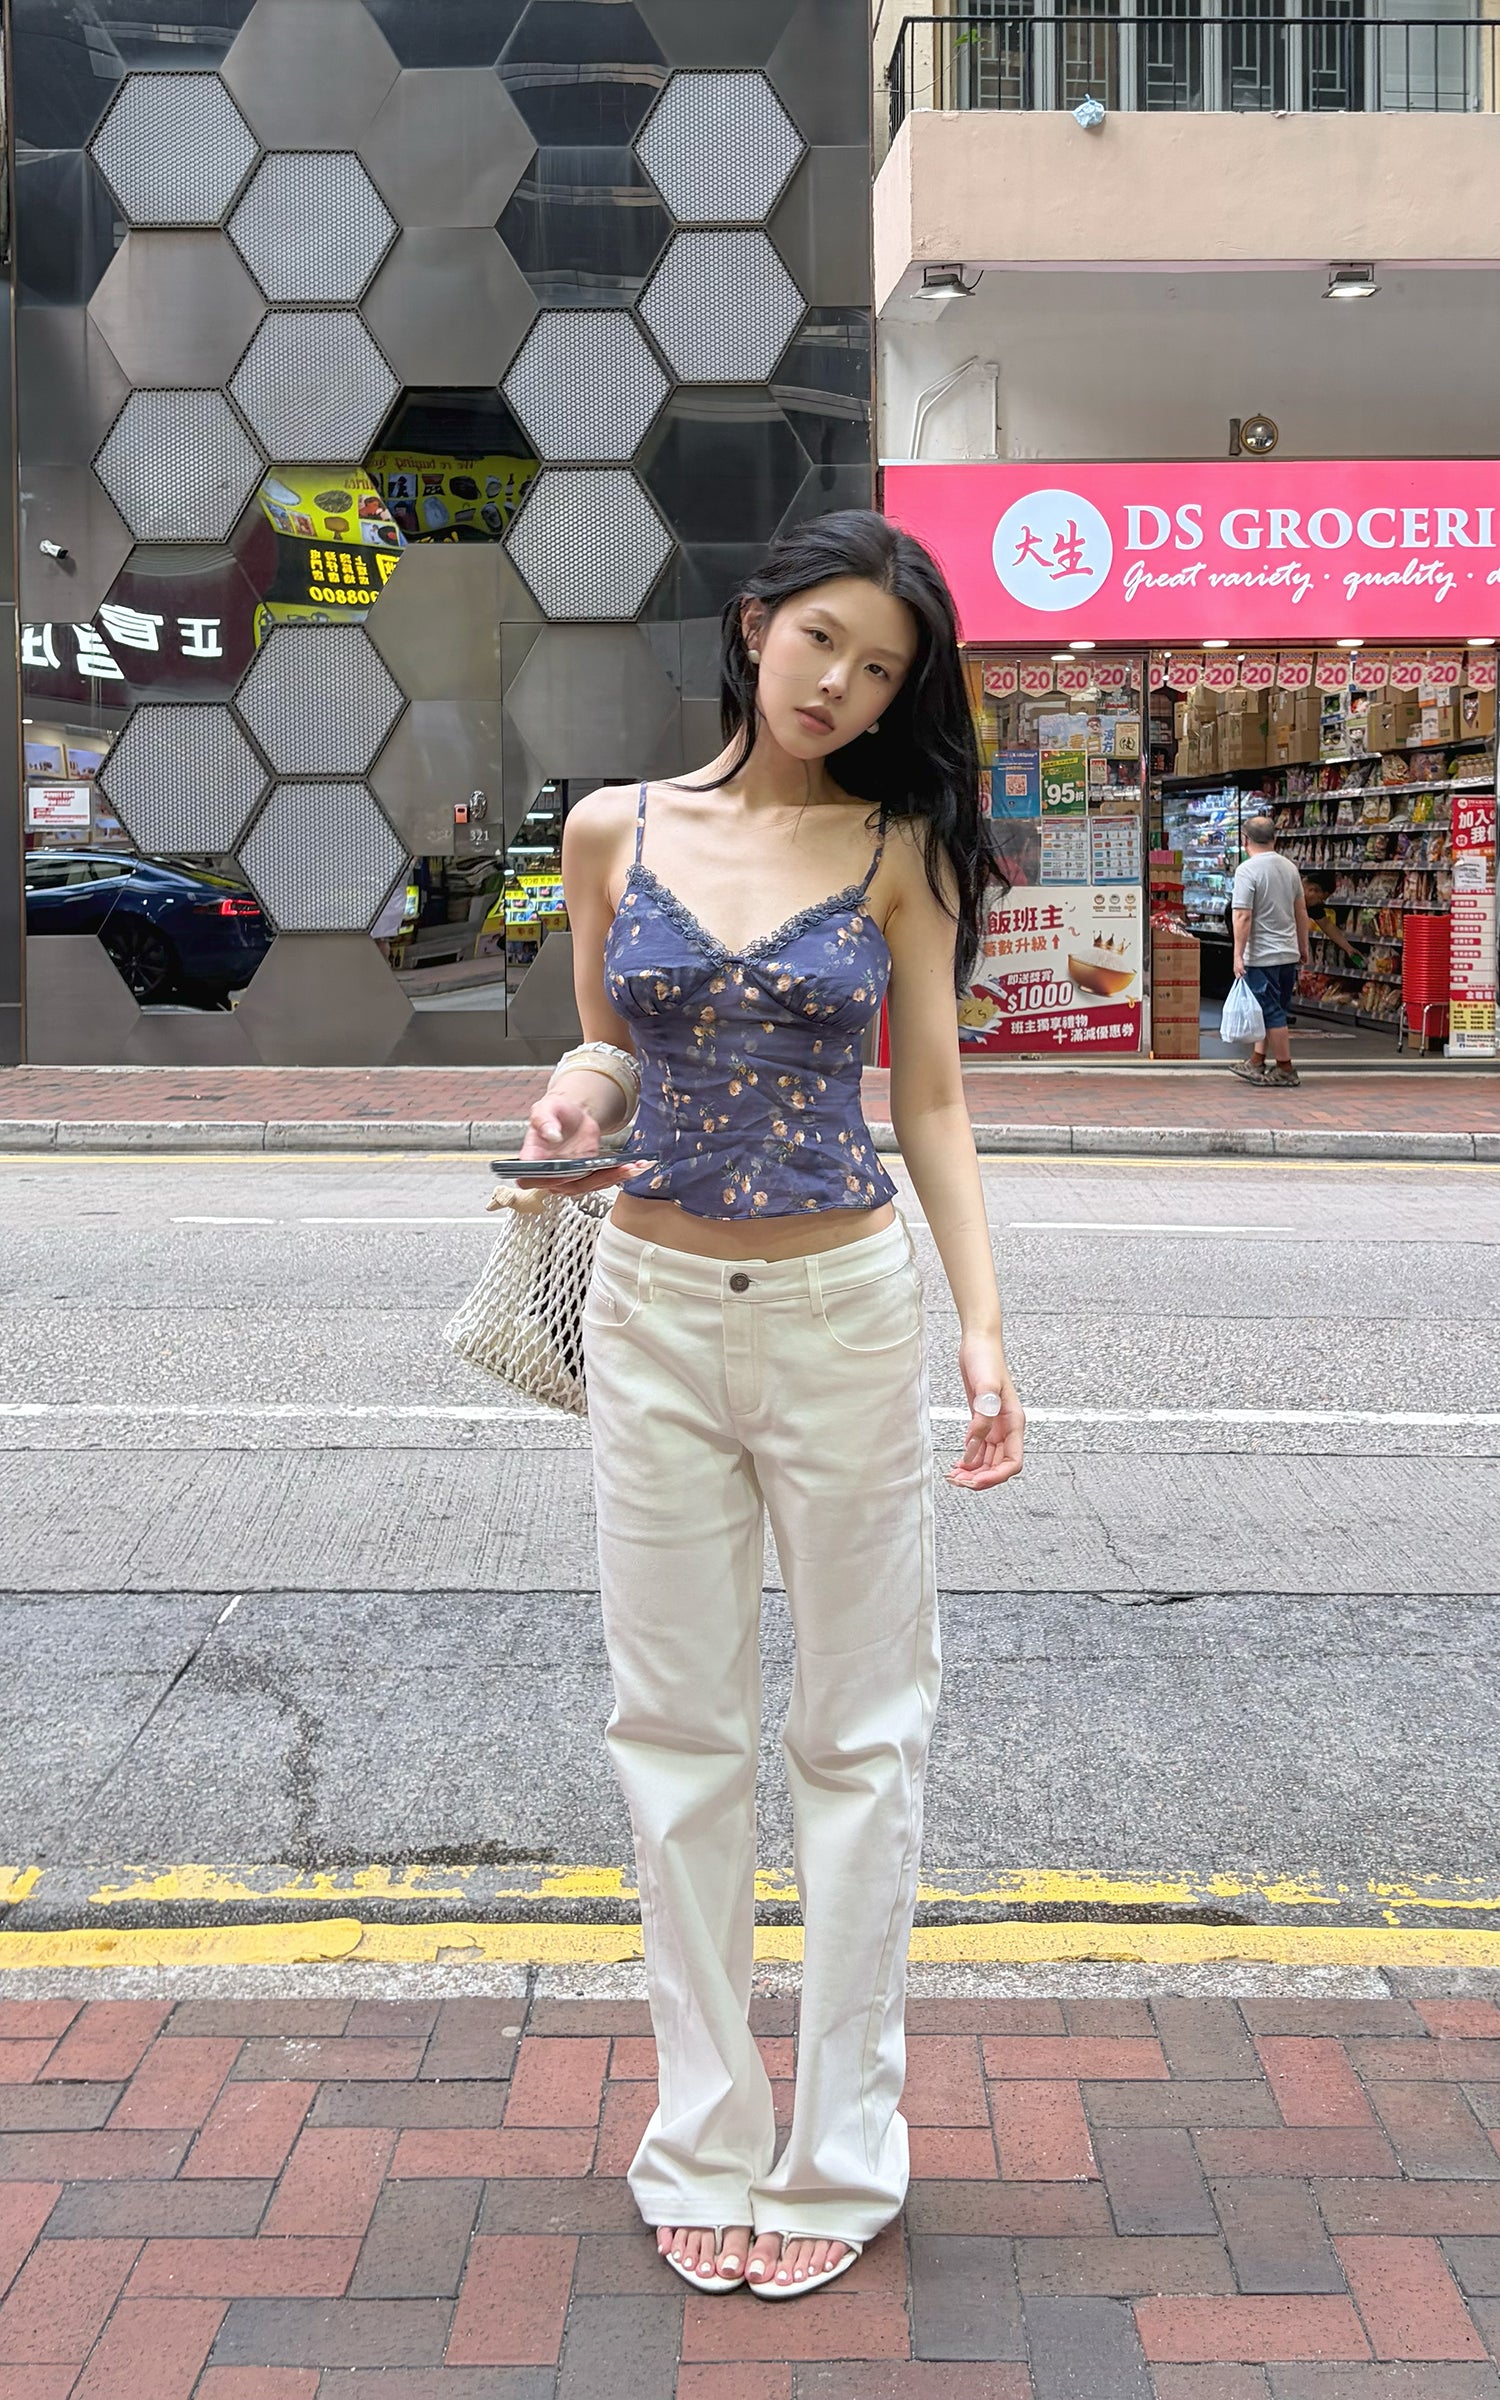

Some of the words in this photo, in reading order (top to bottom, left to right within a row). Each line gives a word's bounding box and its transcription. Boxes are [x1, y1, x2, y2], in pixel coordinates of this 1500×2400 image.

[1123, 504, 1204, 550] DS
[1219, 507, 1497, 550] GROCERI
[1012, 519, 1093, 581] 大生
[1122, 560, 1207, 603] Great
[1208, 560, 1314, 604] variety
[1343, 558, 1457, 603] quality
[985, 671, 1015, 689] $20
[1021, 670, 1050, 689] $20
[1058, 669, 1088, 689] $20
[1094, 668, 1124, 685] $20
[1169, 667, 1199, 685] $20
[1205, 667, 1235, 685] $20
[1242, 666, 1272, 684] $20
[1278, 666, 1308, 685] $20
[1317, 667, 1347, 685] $20
[1355, 666, 1385, 685] $20
[1391, 666, 1422, 685] $20
[1427, 665, 1457, 684] $20
[1458, 809, 1490, 830] 加入
[469, 830, 489, 842] 321
[988, 904, 1064, 936] 飯班主
[1007, 982, 1072, 1012] $1000
